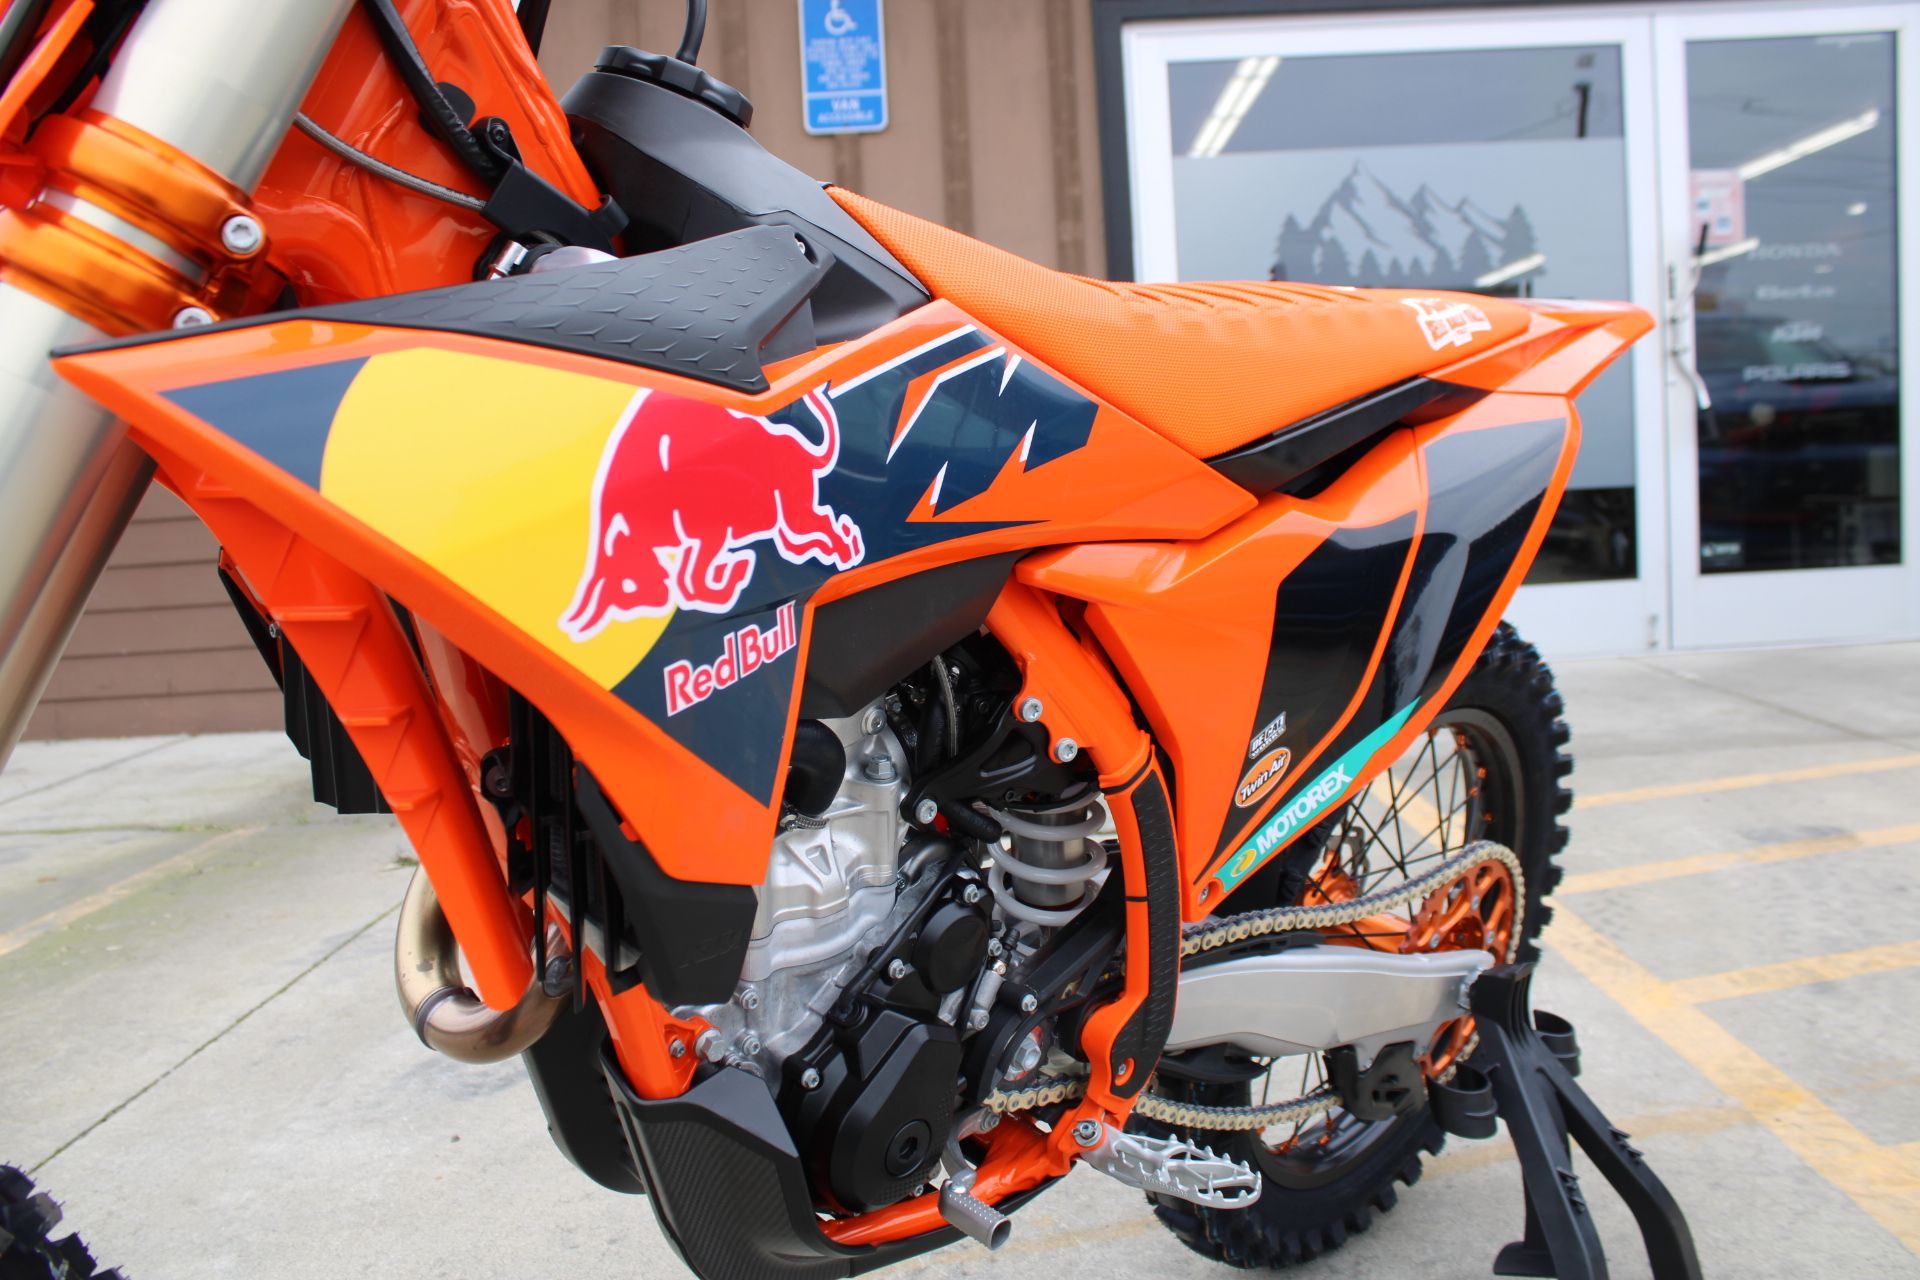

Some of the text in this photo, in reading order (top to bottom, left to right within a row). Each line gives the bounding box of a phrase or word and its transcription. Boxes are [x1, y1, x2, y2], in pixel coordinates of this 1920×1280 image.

[664, 600, 797, 717] Red Bull
[1240, 752, 1288, 801] Twin Air
[1255, 763, 1353, 855] MOTOREX
